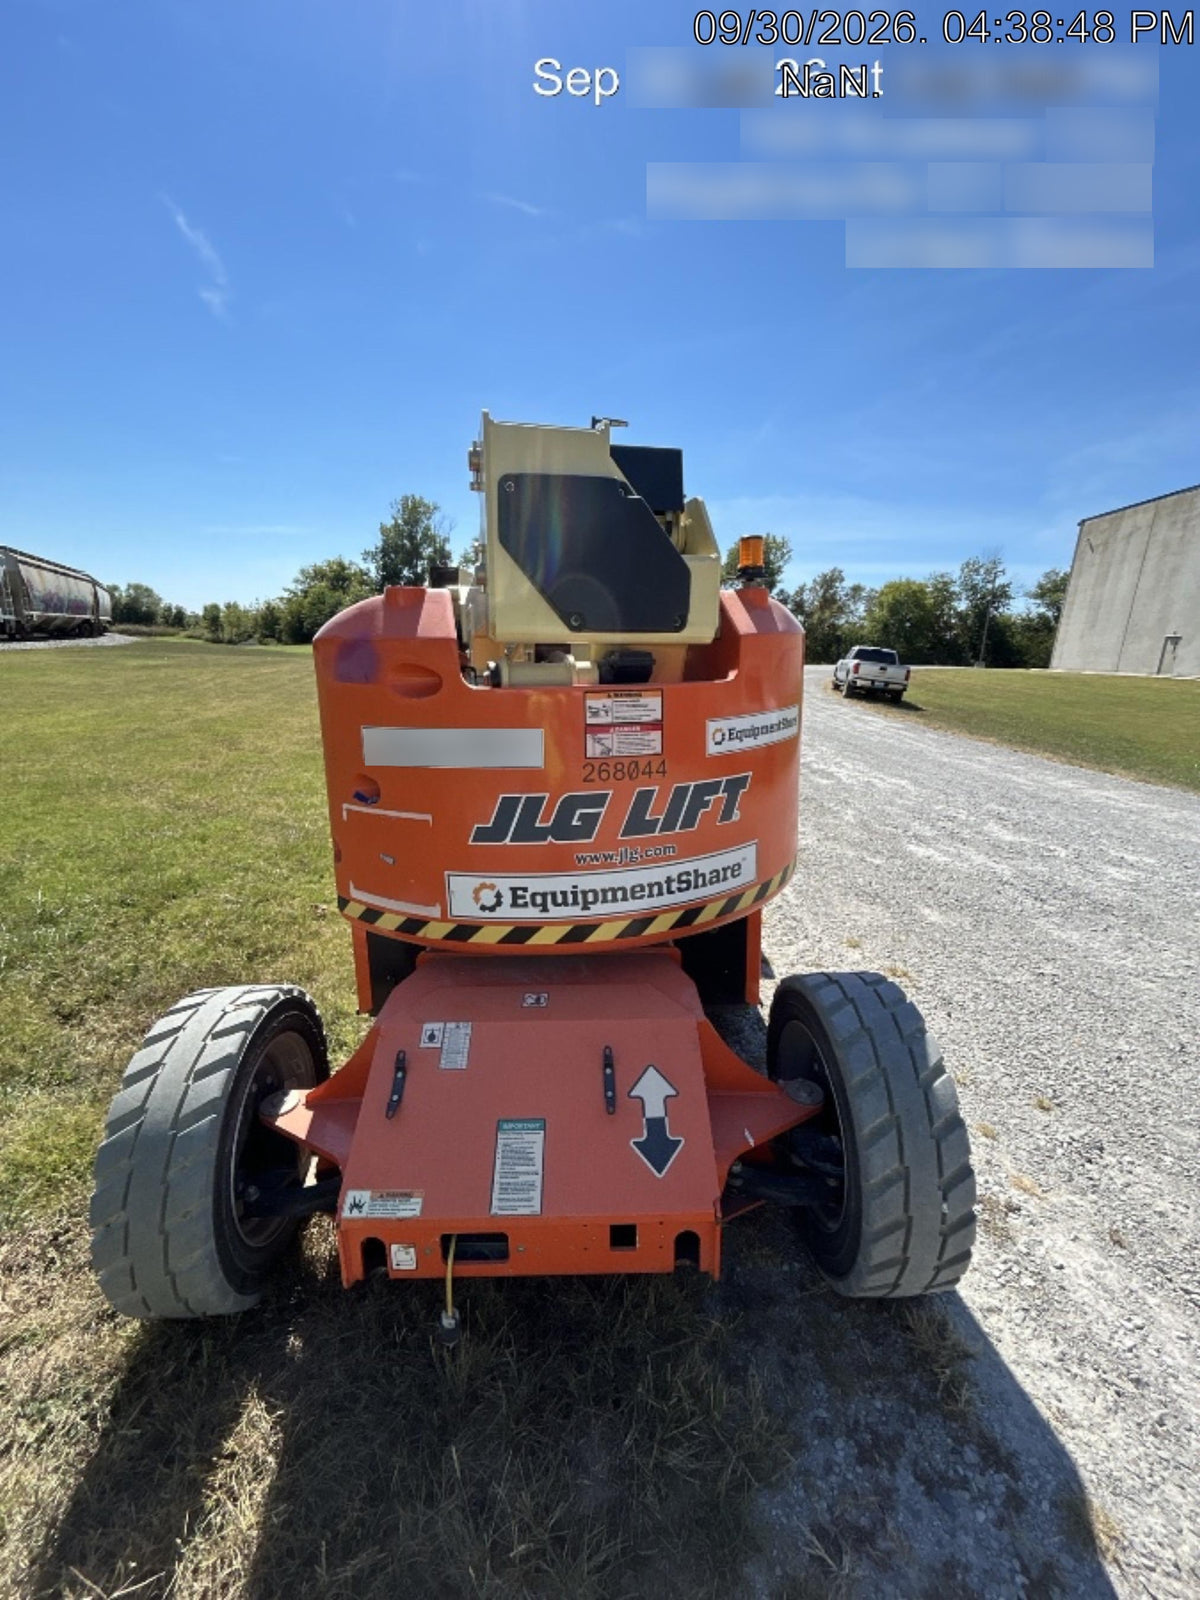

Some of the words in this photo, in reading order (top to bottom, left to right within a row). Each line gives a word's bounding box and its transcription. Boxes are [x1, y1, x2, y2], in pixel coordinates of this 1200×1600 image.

[582, 759, 667, 783] 268044
[468, 789, 614, 845] JLG
[617, 771, 753, 840] LIFT
[575, 843, 677, 866] www.jlg.com
[509, 861, 743, 914] EquipmentShare
